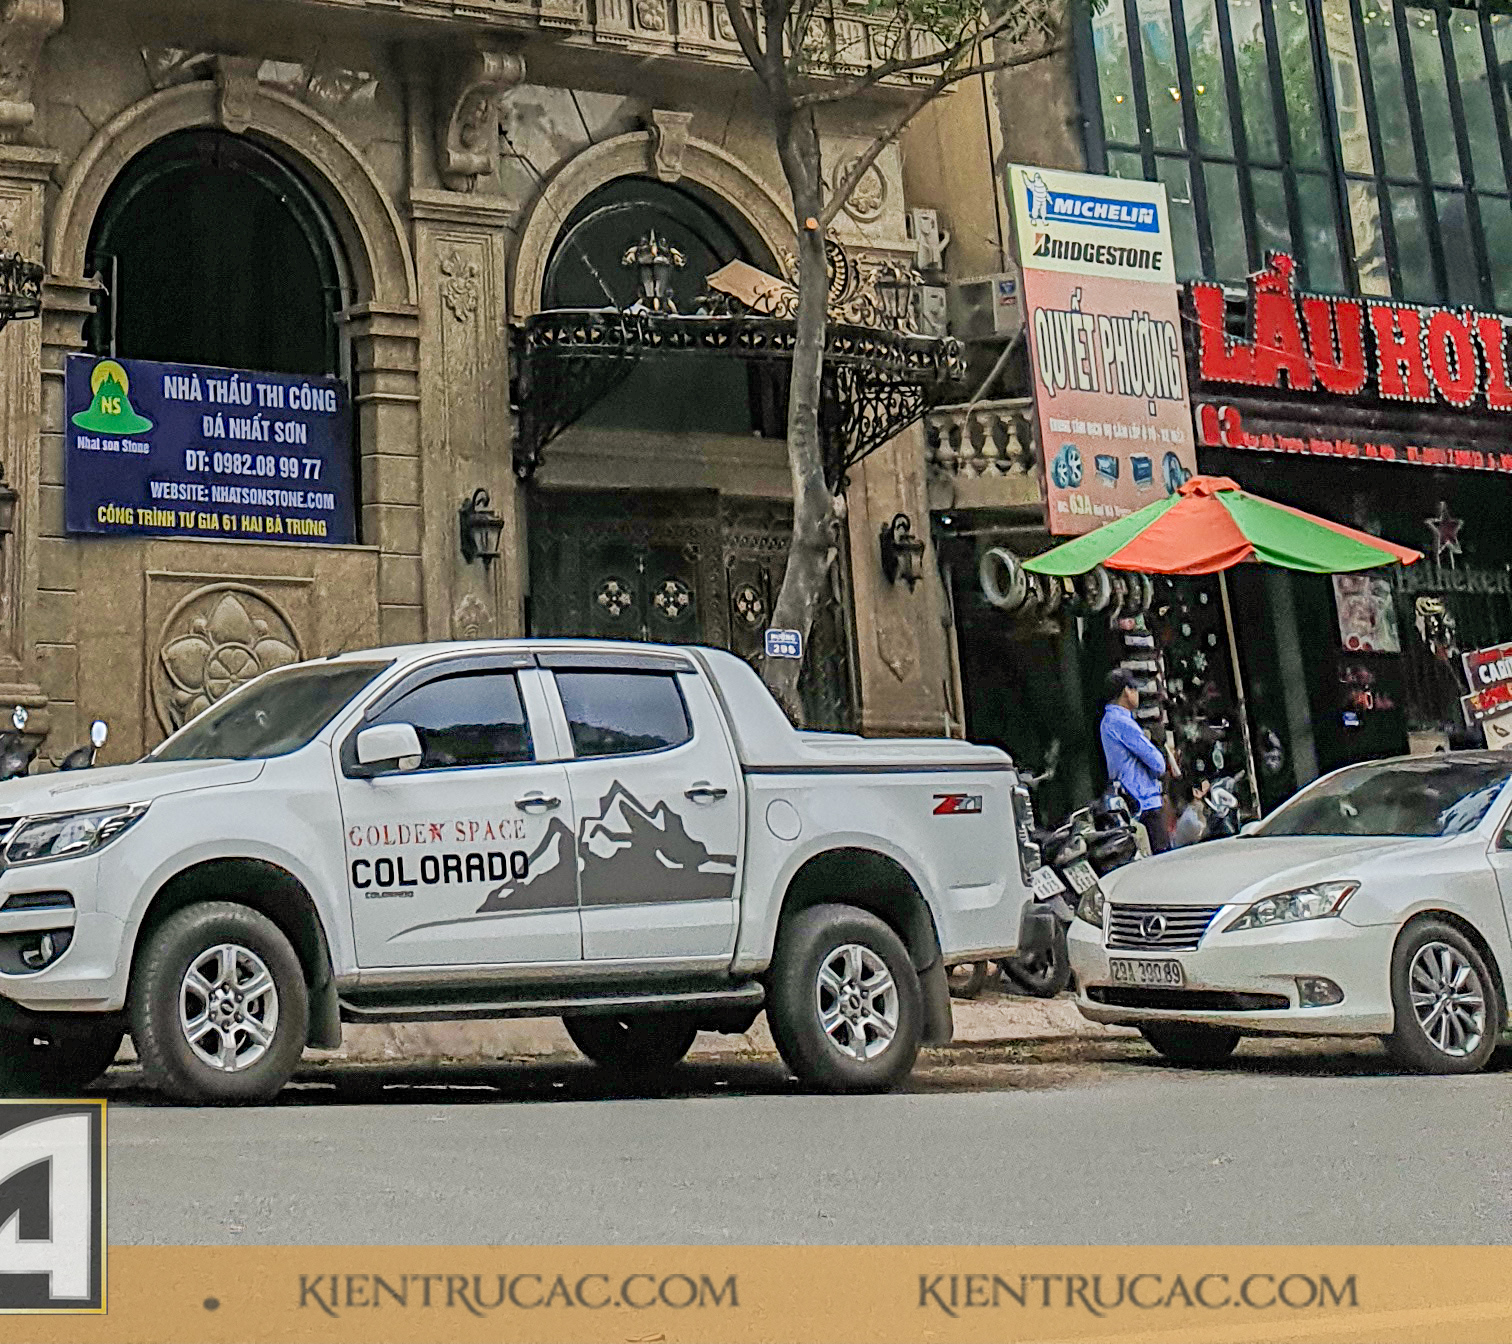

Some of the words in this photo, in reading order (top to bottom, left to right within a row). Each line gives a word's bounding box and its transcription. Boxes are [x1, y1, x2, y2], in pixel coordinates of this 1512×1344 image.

[1053, 197, 1154, 224] MICHELIN
[1033, 233, 1163, 271] BRIDGESTONE
[1034, 287, 1099, 398] QUYẾT
[1098, 310, 1183, 417] PHƯỢNG
[101, 396, 121, 414] NS
[164, 373, 202, 402] NHÀ
[256, 384, 284, 408] THI
[289, 383, 337, 412] CÔNG
[203, 413, 226, 439] ĐÁ
[229, 413, 270, 442] NHẤT
[274, 421, 307, 444] SƠN
[186, 450, 210, 472] ĐT:
[213, 451, 275, 477] 0982.08
[279, 457, 299, 479] 99
[302, 458, 322, 480] 77
[150, 481, 209, 502] WEBSITE:
[211, 485, 335, 510] NHATSONSTONE.COM
[137, 508, 176, 528] TRÌNH
[197, 513, 220, 531] GIA
[222, 514, 237, 531] 61
[241, 515, 263, 533] HAI
[349, 822, 445, 847] GOLDEN
[455, 818, 526, 842] SPACE
[351, 850, 529, 889] COLORADO
